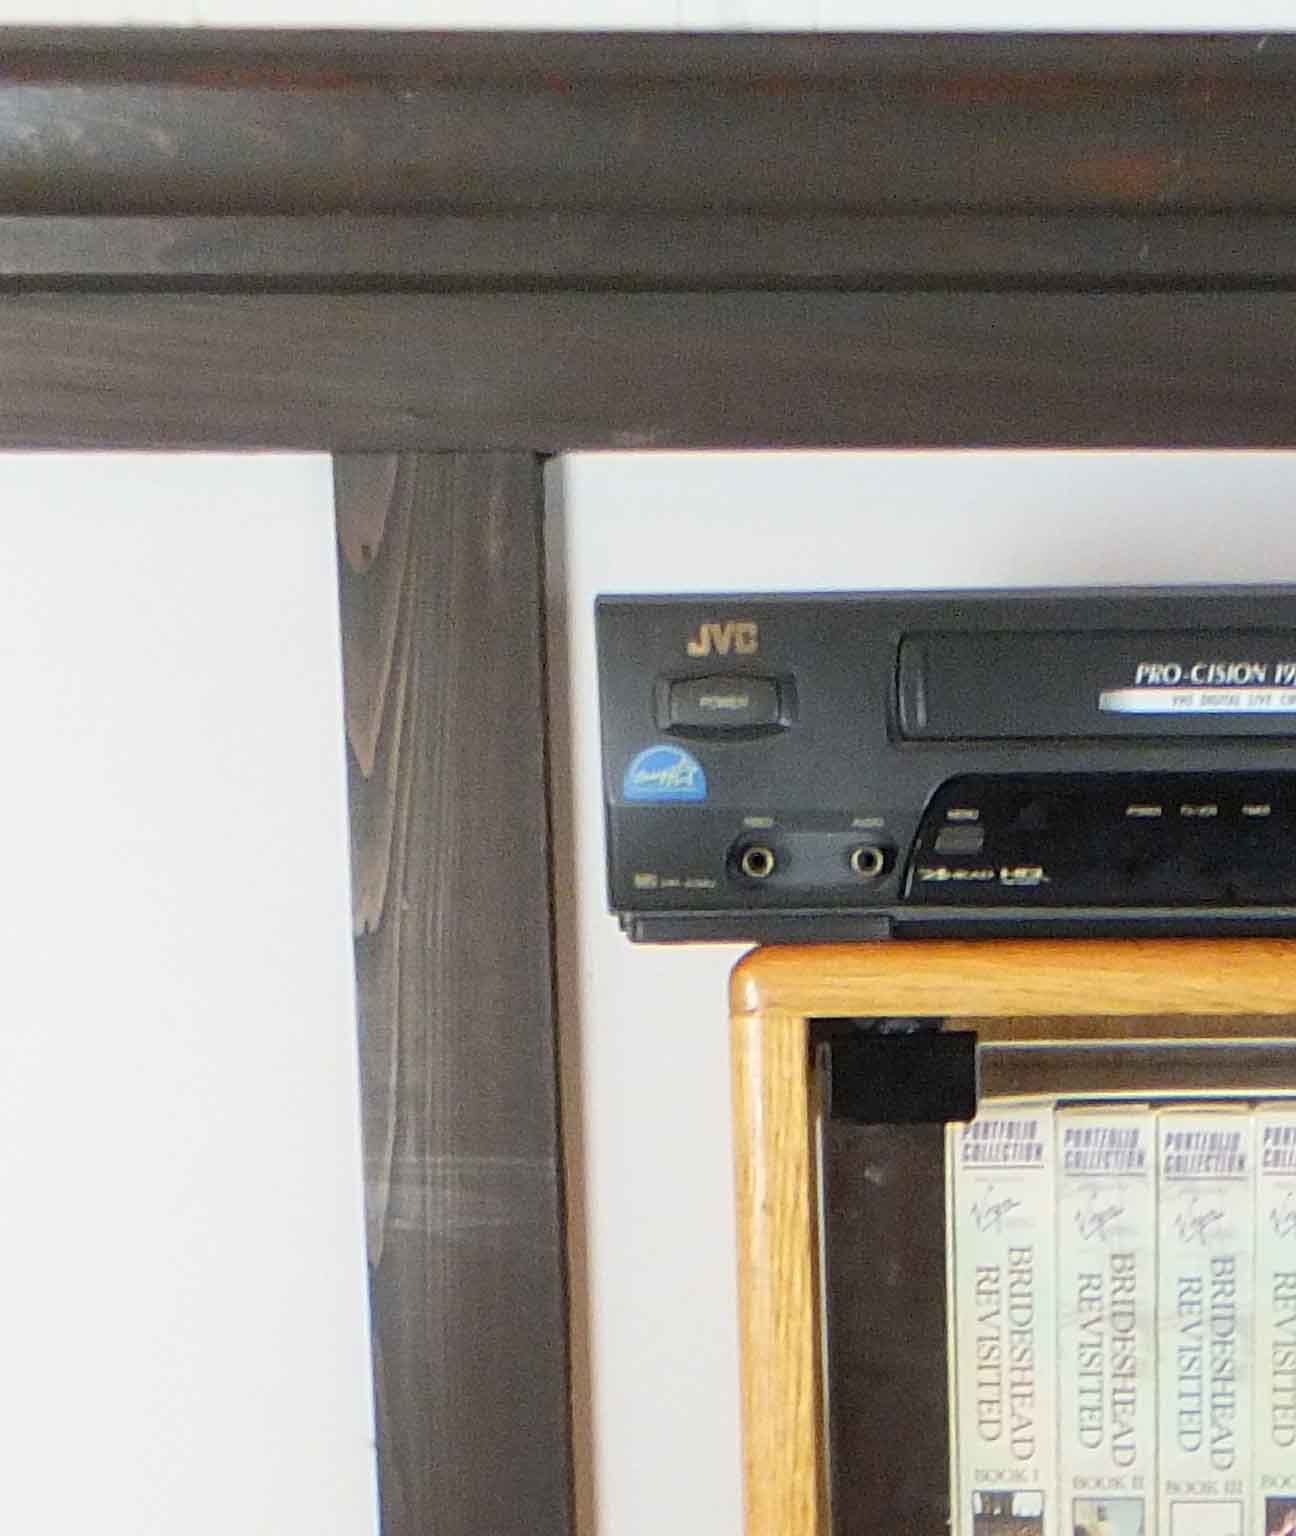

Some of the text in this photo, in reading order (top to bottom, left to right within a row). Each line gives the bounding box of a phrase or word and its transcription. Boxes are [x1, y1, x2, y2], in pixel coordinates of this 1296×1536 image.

[687, 621, 759, 657] JVC
[1135, 663, 1267, 685] PRO-CISION
[963, 1119, 1039, 1141] PORTFOLIO
[1064, 1127, 1140, 1149] PORTFOLIO
[962, 1142, 1044, 1163] COLLECTION
[1164, 1131, 1241, 1153] PORTFOLIO
[1064, 1150, 1145, 1170] COLLECTION
[1163, 1154, 1246, 1174] COLLECTION
[975, 1264, 1002, 1443] REVISITED
[1008, 1245, 1035, 1462] BRIDESHEAD
[1077, 1272, 1103, 1450] REVISITED
[1110, 1252, 1137, 1469] BRIDESHEAD
[1176, 1276, 1203, 1453] REVISITED
[1210, 1255, 1236, 1472] BRIDESHEAD
[1271, 1272, 1296, 1448] REVISITED
[975, 1468, 1027, 1482] BOOK
[1072, 1476, 1127, 1490] BOOK
[1166, 1481, 1219, 1495] BOOK
